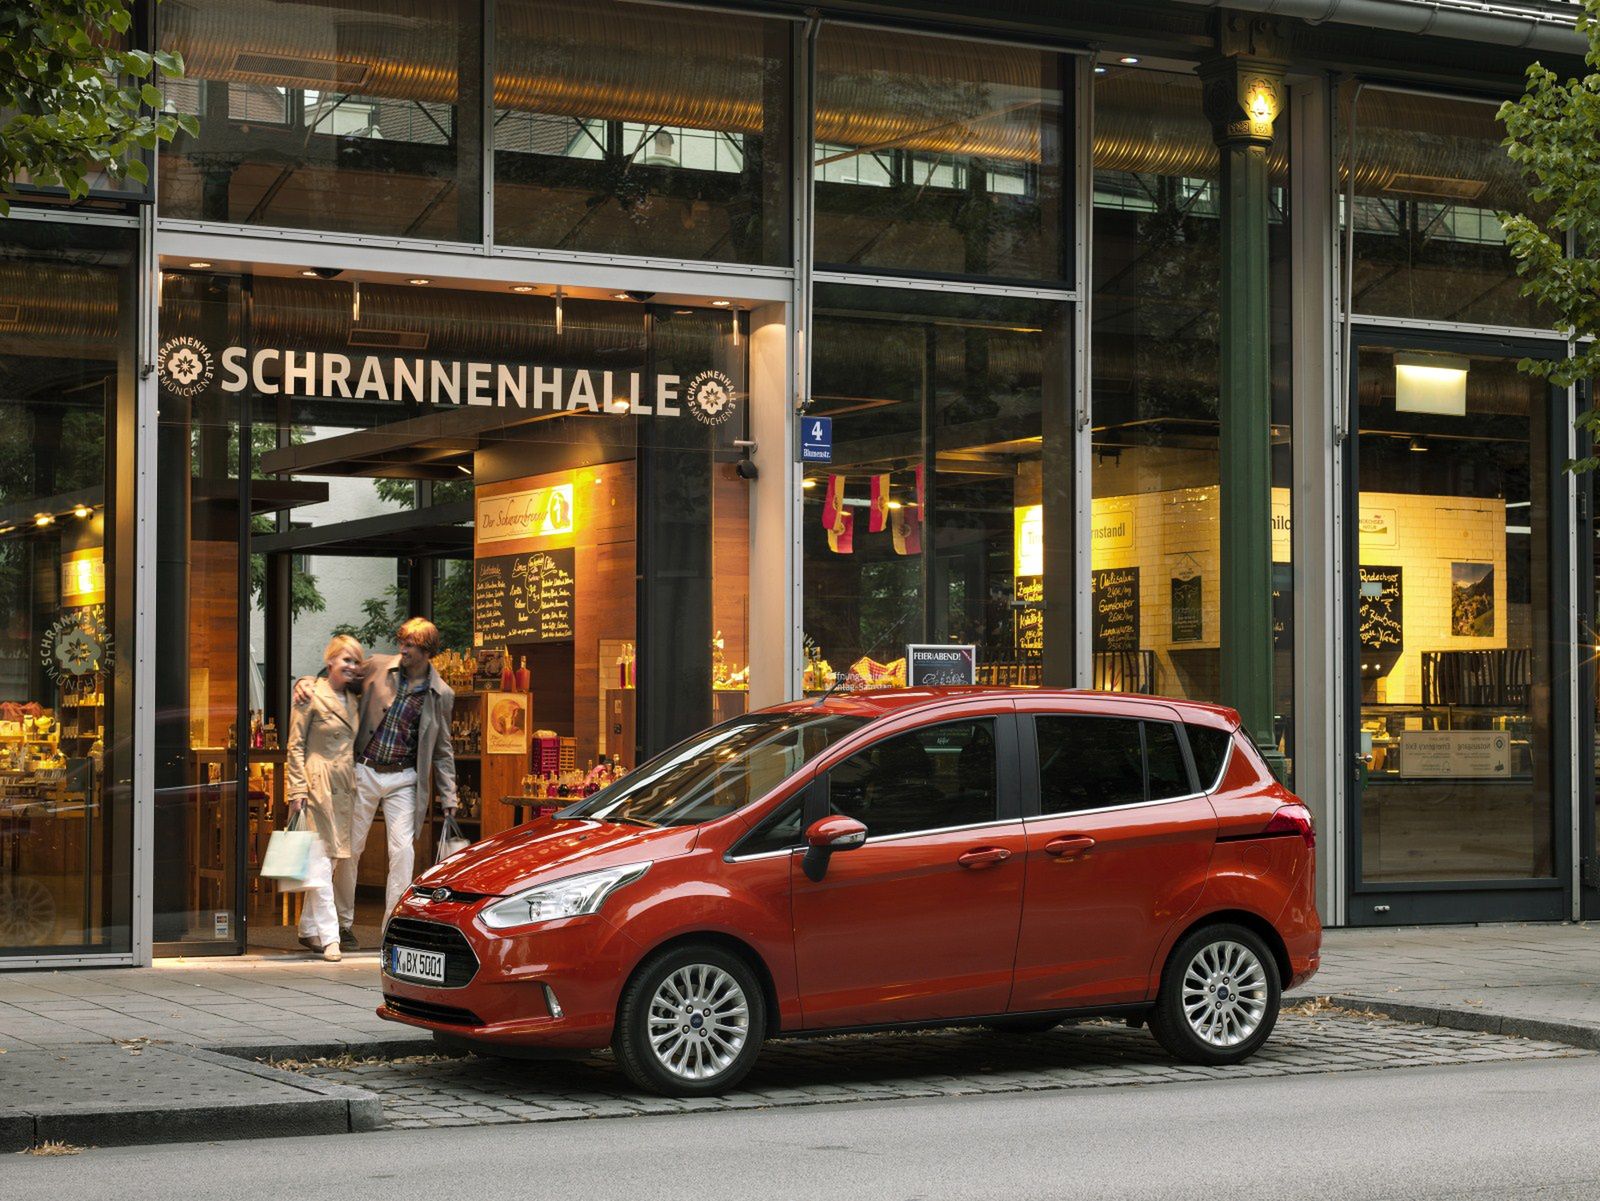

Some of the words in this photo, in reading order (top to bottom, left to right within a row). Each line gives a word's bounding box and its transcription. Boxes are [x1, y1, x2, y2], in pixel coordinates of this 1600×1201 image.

[157, 336, 214, 379] SCHRANNENHALLE
[221, 346, 681, 417] SCHRANNENHALLE
[687, 370, 736, 409] SCHRANNENHALLE
[811, 421, 823, 441] 4
[803, 448, 831, 458] Blumenstr.
[407, 951, 418, 974] BX
[419, 954, 442, 978] 5001
